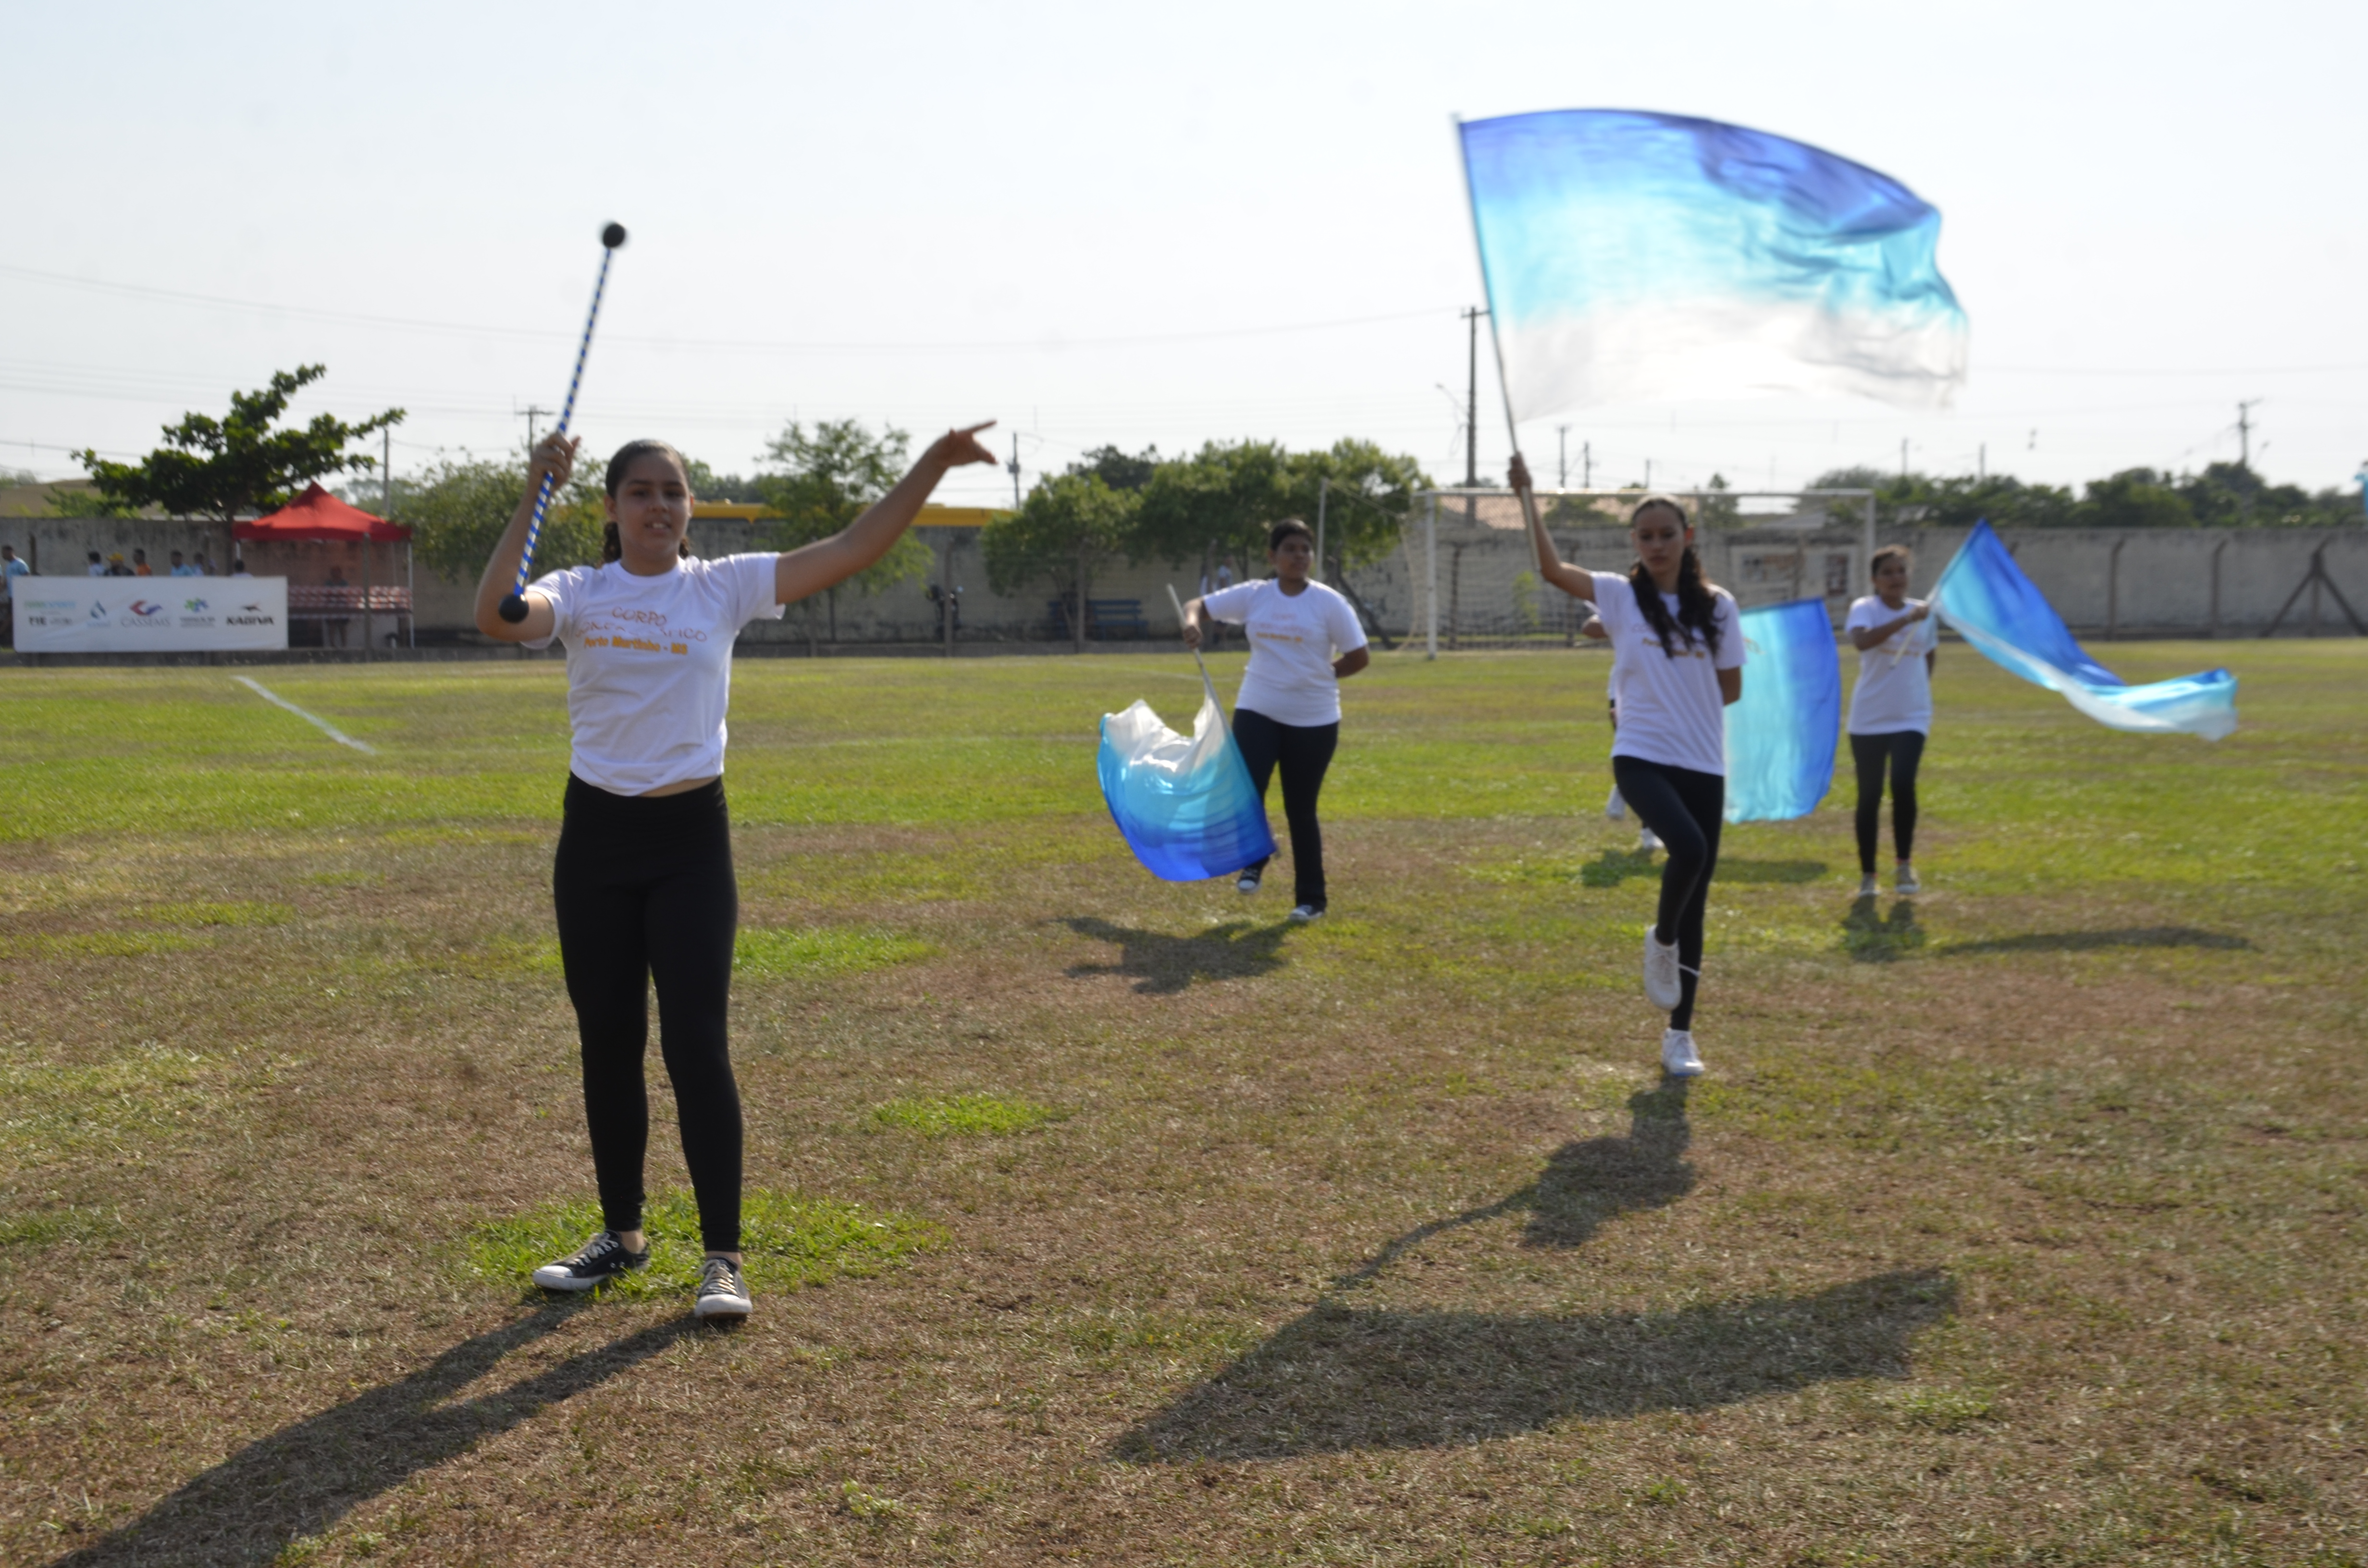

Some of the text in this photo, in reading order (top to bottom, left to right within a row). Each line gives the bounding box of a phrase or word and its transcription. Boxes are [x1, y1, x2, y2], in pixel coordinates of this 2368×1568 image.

[612, 606, 667, 626] CORPO
[584, 637, 608, 649] Porto
[671, 642, 688, 654] MS
